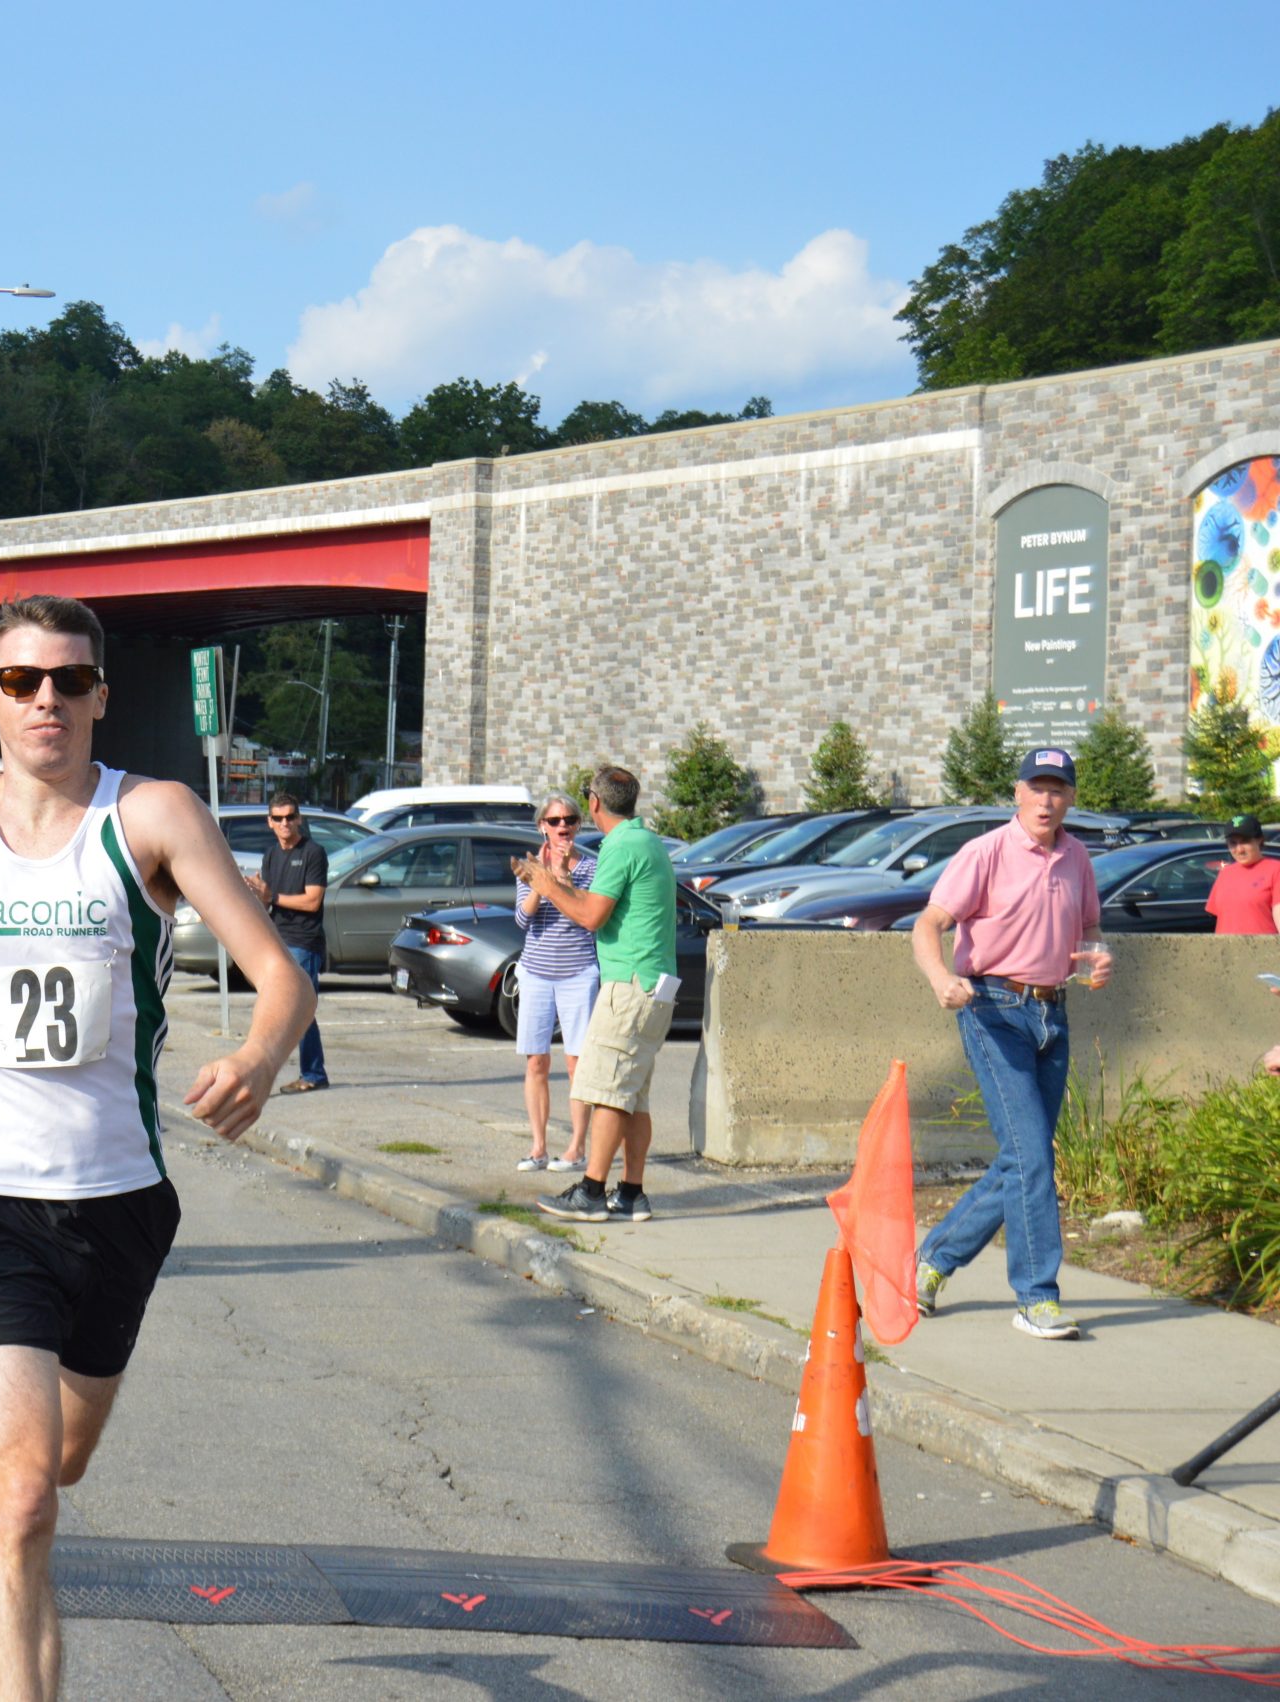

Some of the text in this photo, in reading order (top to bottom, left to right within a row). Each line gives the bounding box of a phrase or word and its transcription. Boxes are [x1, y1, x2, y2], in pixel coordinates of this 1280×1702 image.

[1021, 528, 1087, 549] PETER BYNUM
[1014, 565, 1091, 619] LIFE
[1024, 639, 1077, 652] New Paintings
[23, 927, 107, 937] ROAD RUNNERS
[10, 966, 78, 1063] 23
